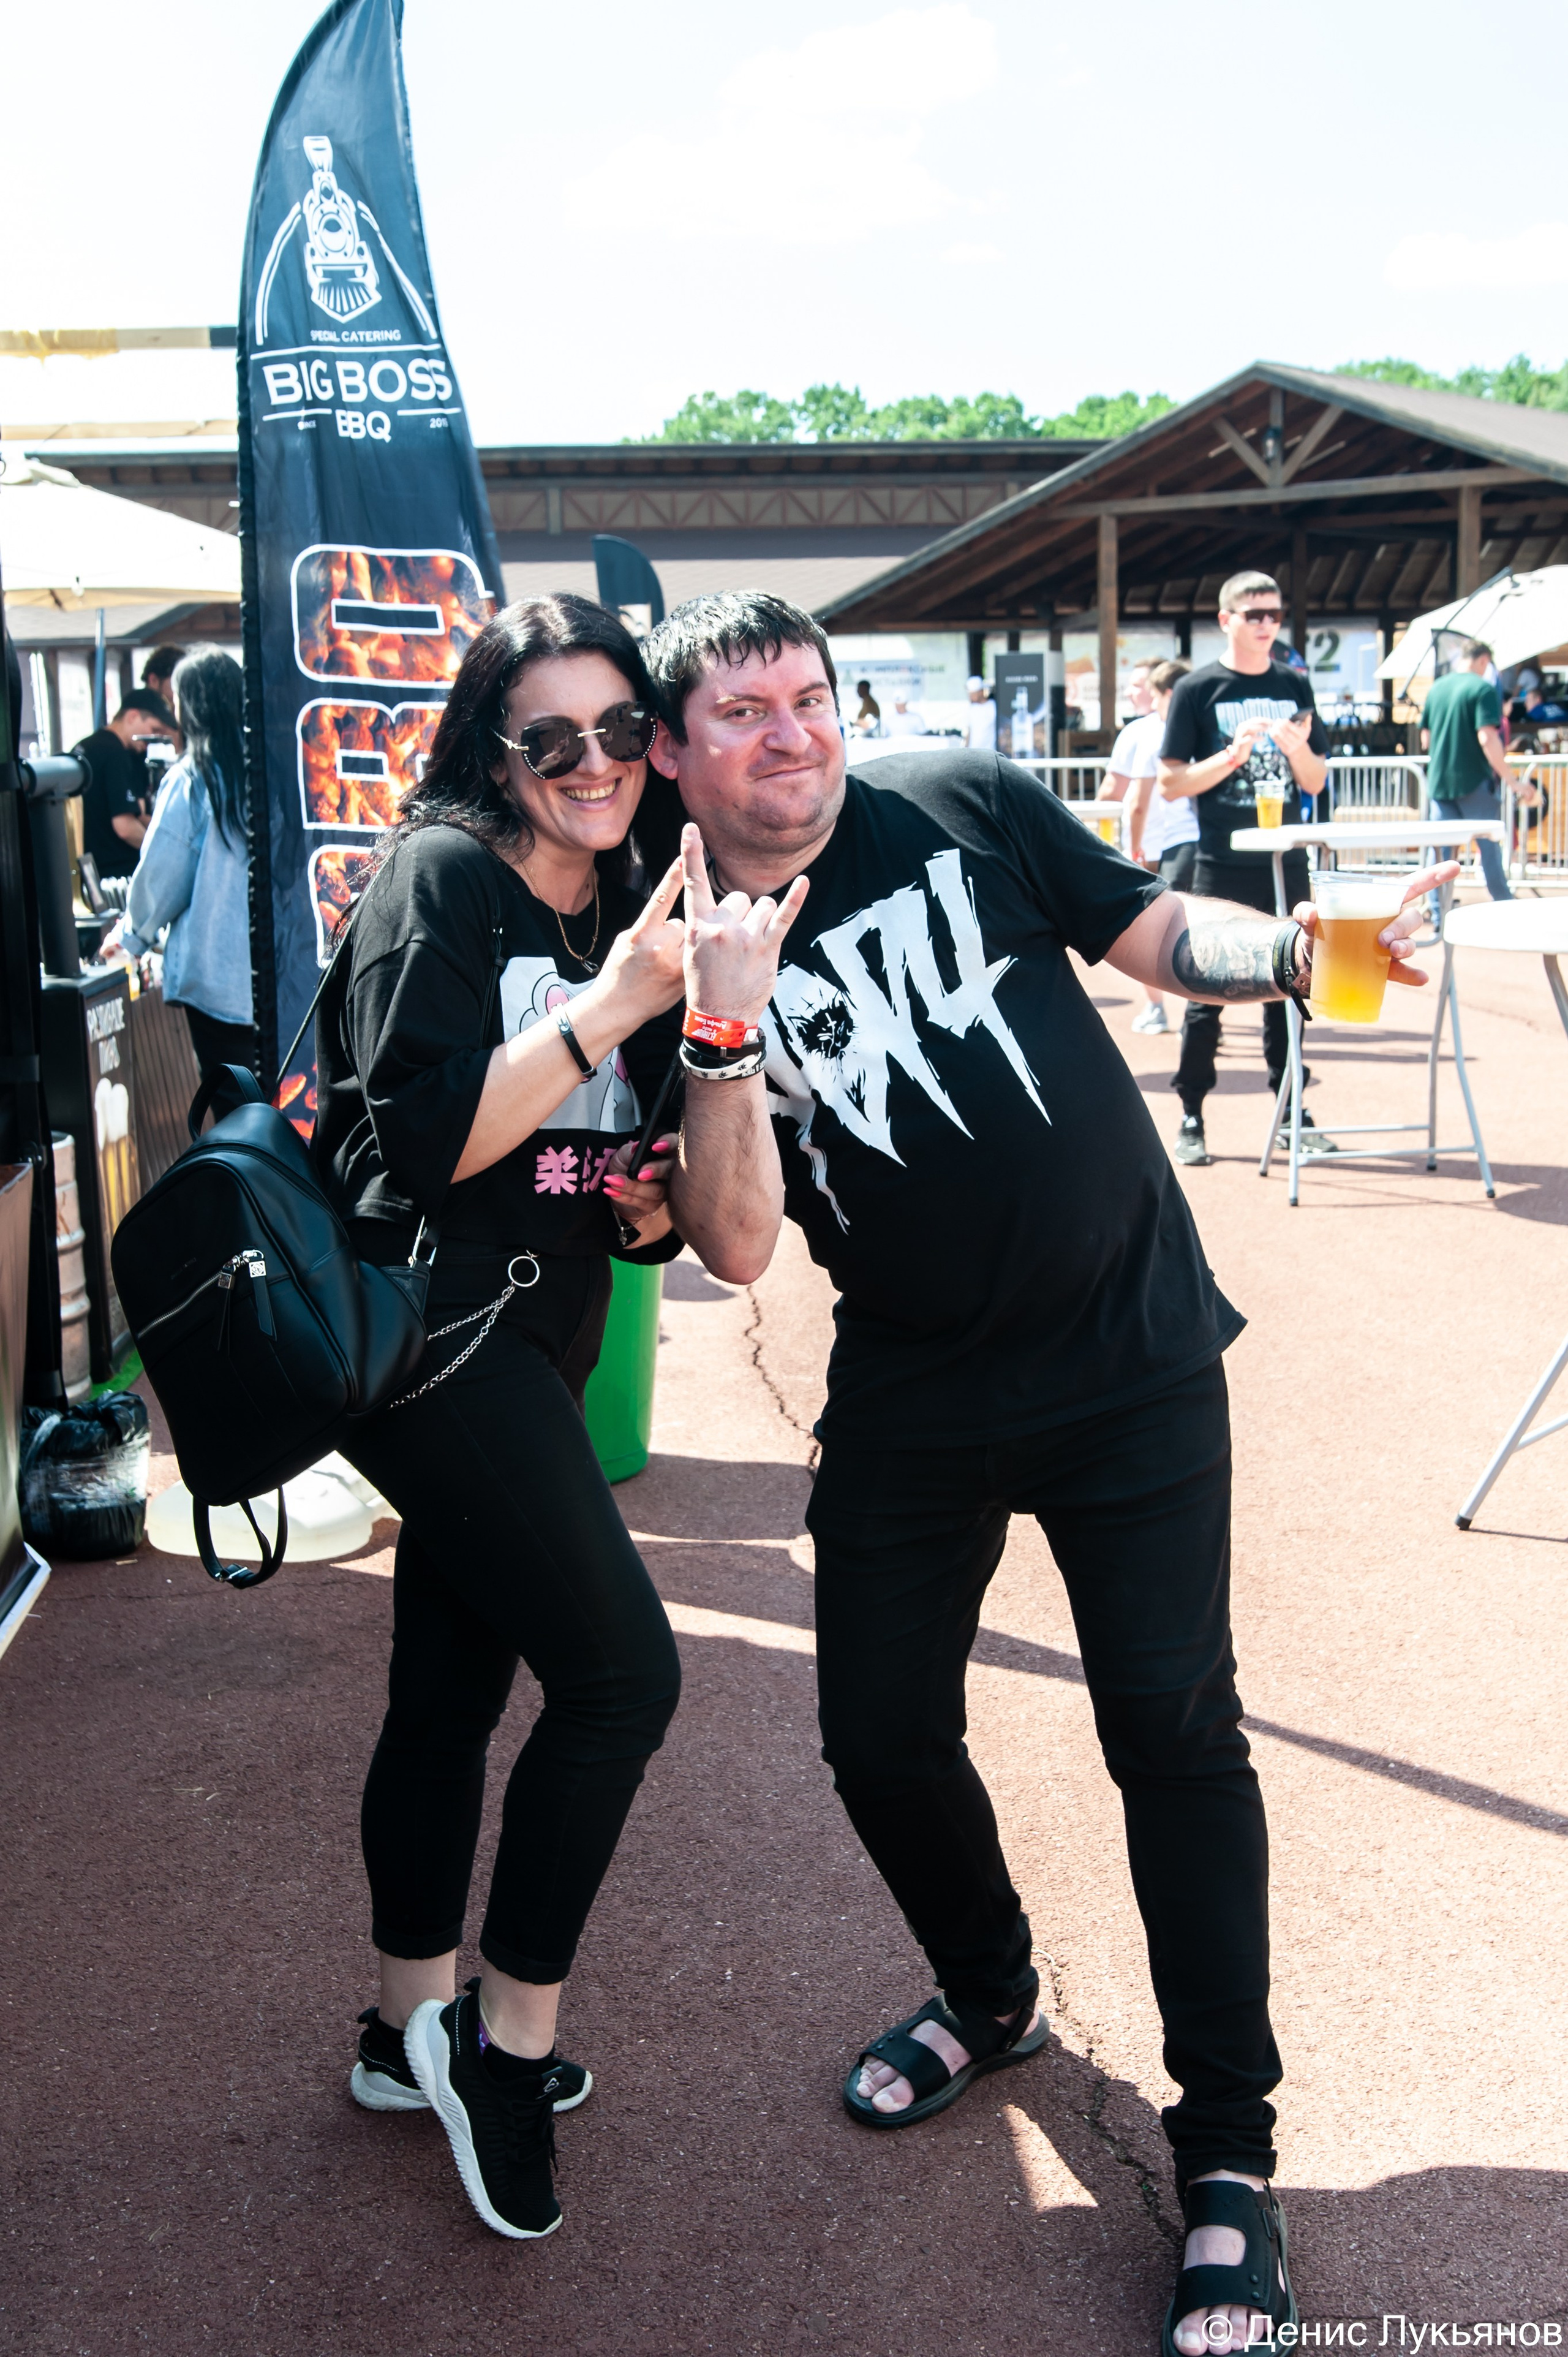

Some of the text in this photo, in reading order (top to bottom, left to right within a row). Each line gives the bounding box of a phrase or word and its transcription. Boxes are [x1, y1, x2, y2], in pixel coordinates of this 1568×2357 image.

[341, 329, 402, 342] CATERING
[262, 358, 453, 405] BIG BOSS
[335, 409, 392, 443] BBQ
